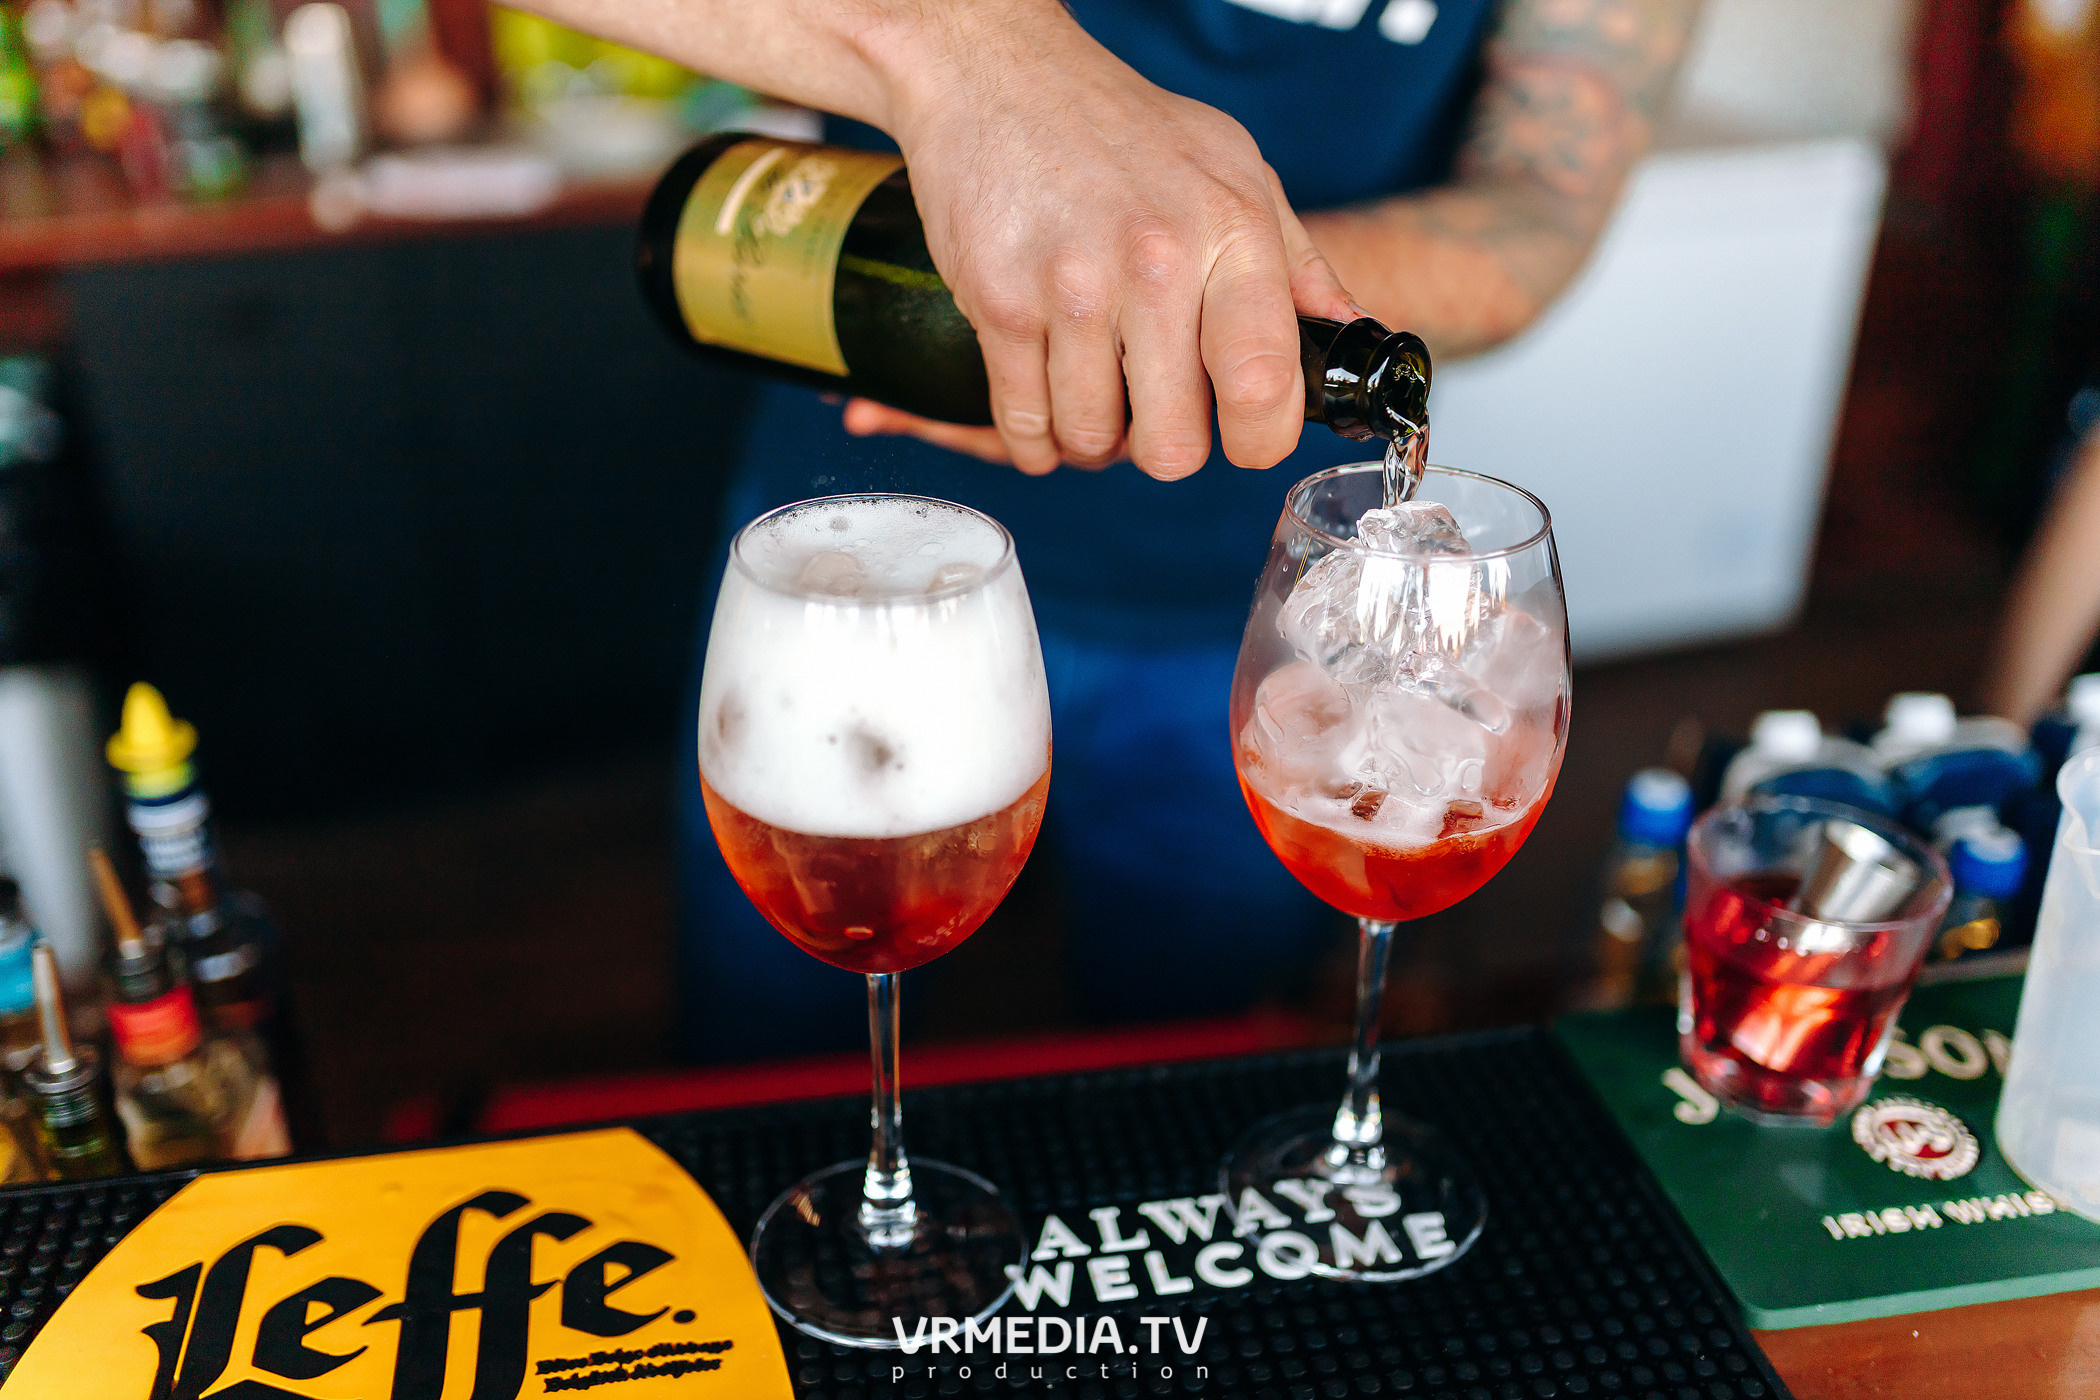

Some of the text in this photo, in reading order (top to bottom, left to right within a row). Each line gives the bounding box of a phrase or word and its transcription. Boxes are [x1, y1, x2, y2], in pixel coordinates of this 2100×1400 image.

[1030, 1177, 1402, 1262] ALWAYS
[1822, 1190, 2056, 1241] IRISH WHIS
[1003, 1211, 1457, 1312] WELCOME
